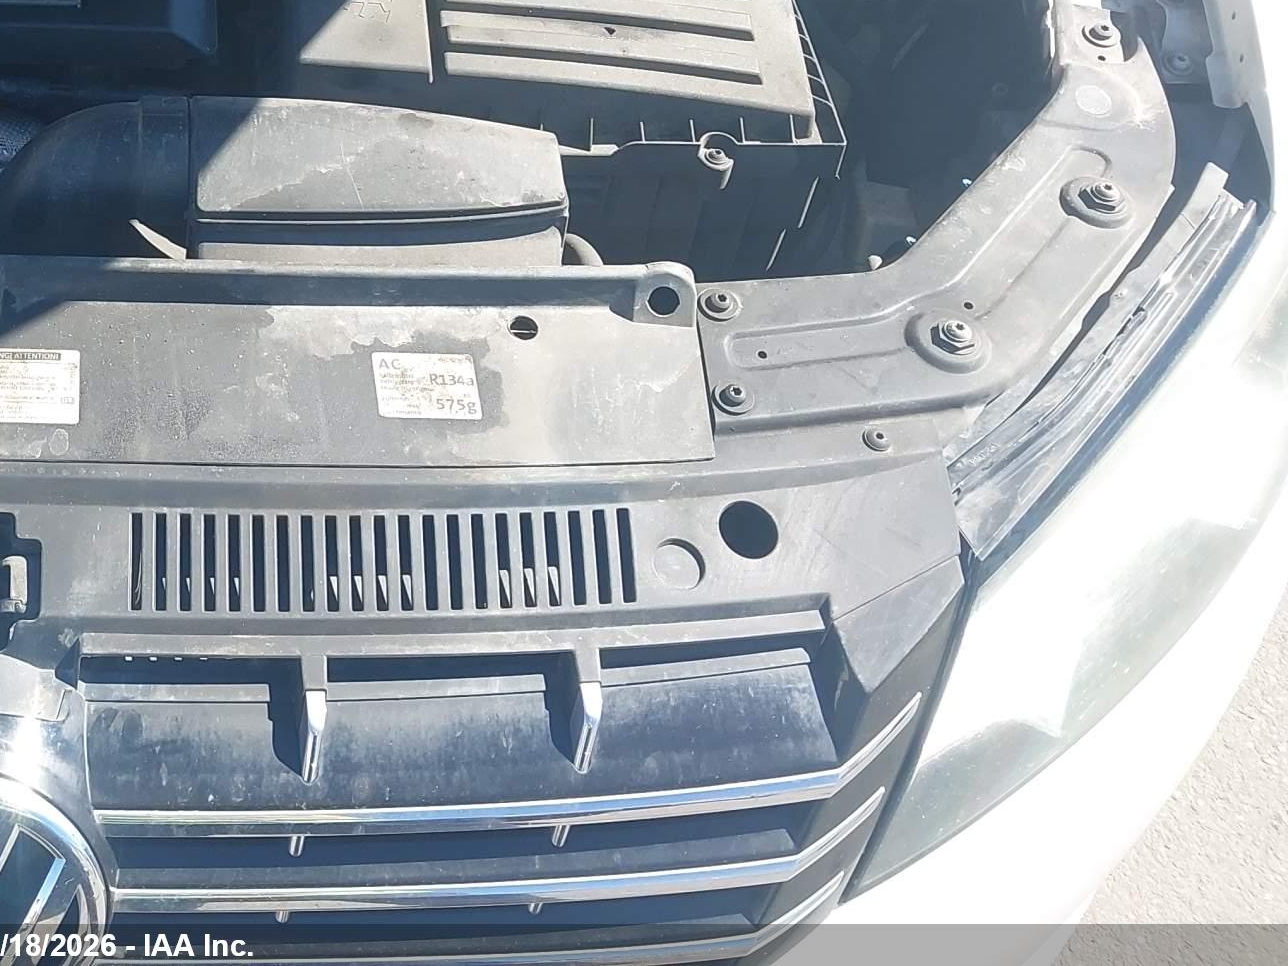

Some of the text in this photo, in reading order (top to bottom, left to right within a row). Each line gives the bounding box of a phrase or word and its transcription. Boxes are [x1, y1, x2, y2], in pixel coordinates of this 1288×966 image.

[379, 358, 401, 370] AC
[429, 373, 475, 387] R134a
[436, 398, 478, 415] 575g
